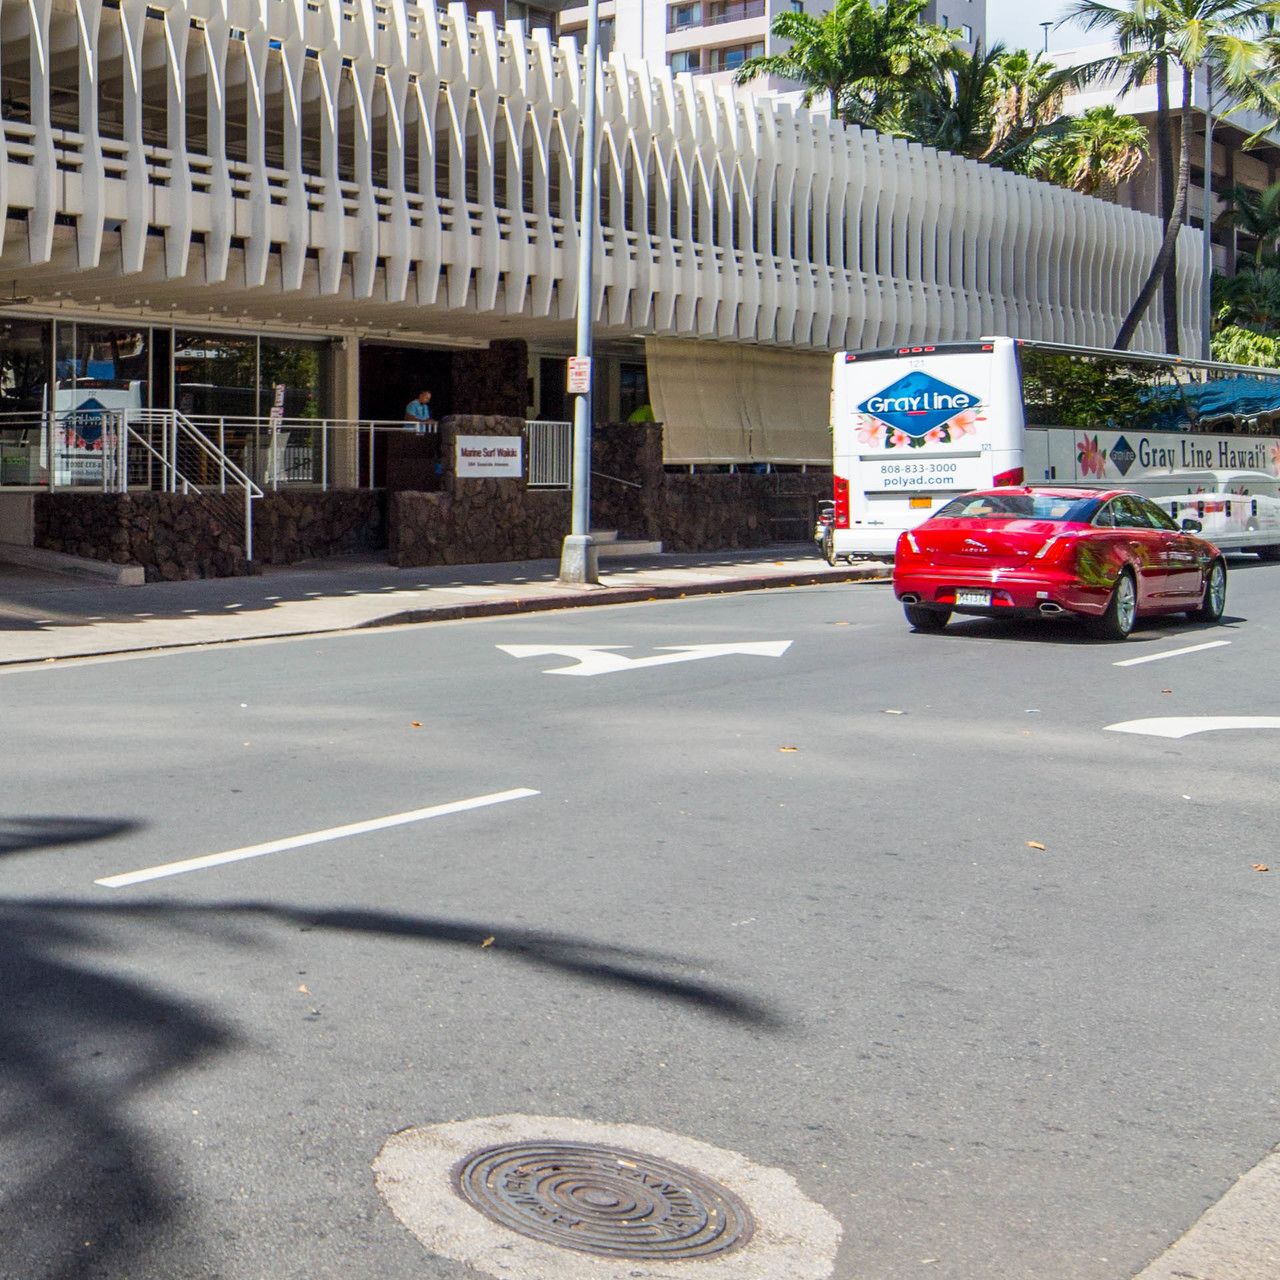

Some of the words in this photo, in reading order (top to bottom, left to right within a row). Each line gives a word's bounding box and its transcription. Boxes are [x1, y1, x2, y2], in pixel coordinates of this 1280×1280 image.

[461, 447, 482, 457] Marine
[482, 447, 496, 457] Surf
[1139, 438, 1175, 472] Gray
[1182, 440, 1213, 468] Line
[880, 464, 957, 474] 808-833-3000
[884, 476, 954, 487] polyad.com
